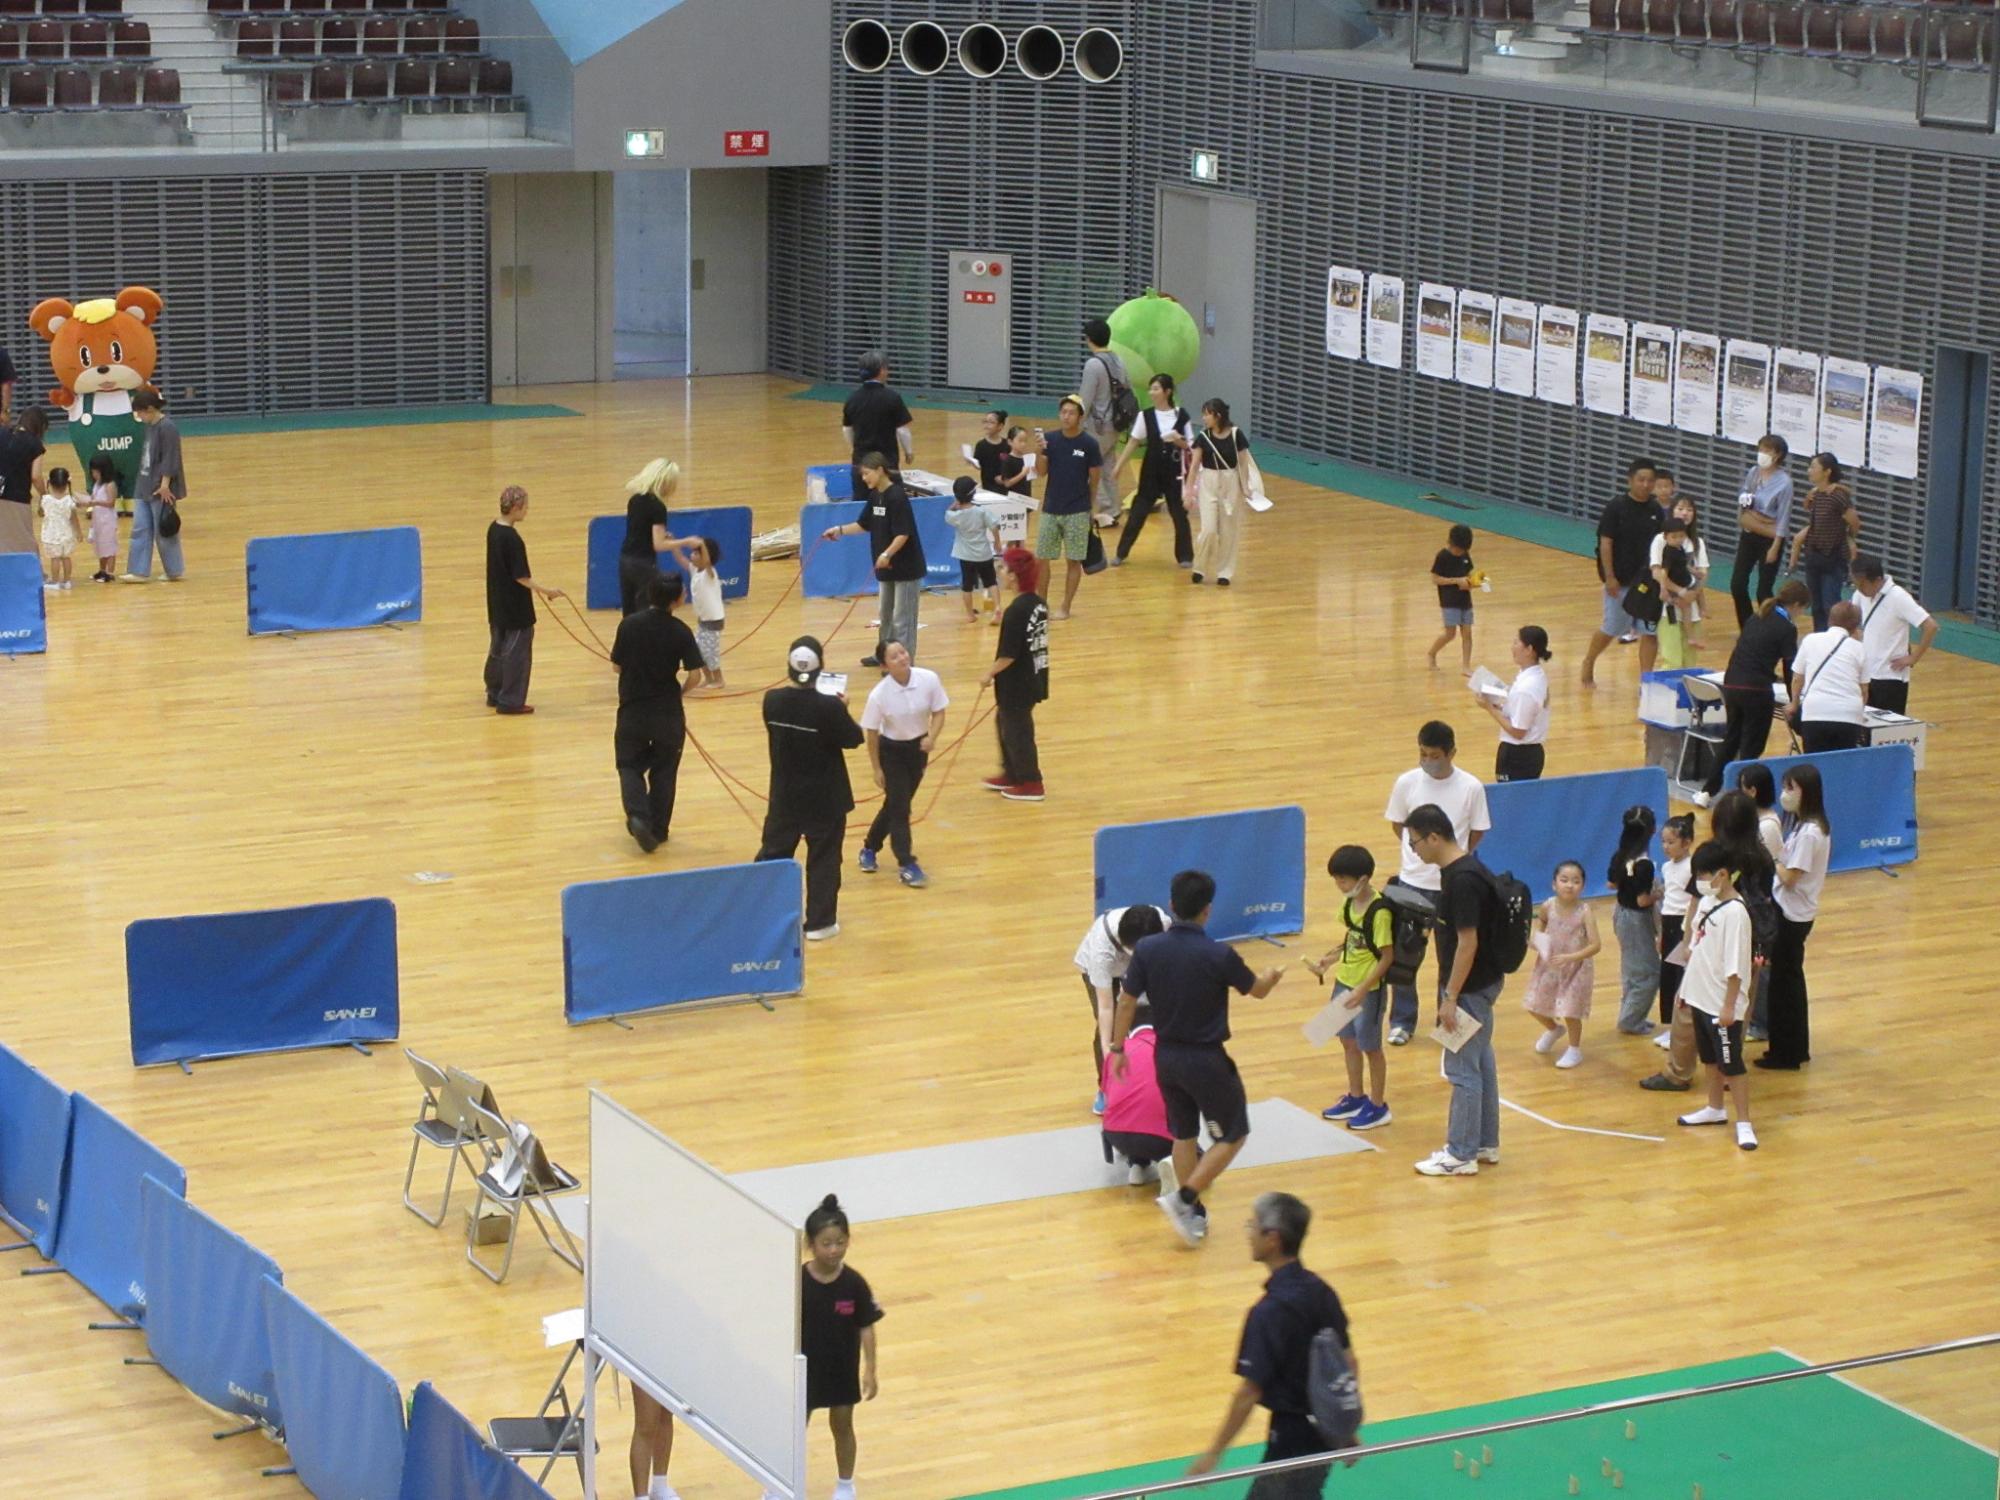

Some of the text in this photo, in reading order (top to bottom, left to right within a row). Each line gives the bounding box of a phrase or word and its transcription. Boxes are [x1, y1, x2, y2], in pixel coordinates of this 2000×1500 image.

[730, 134, 765, 148] 禁煙
[97, 435, 133, 450] JUMP
[323, 1007, 377, 1021] SAN-EI
